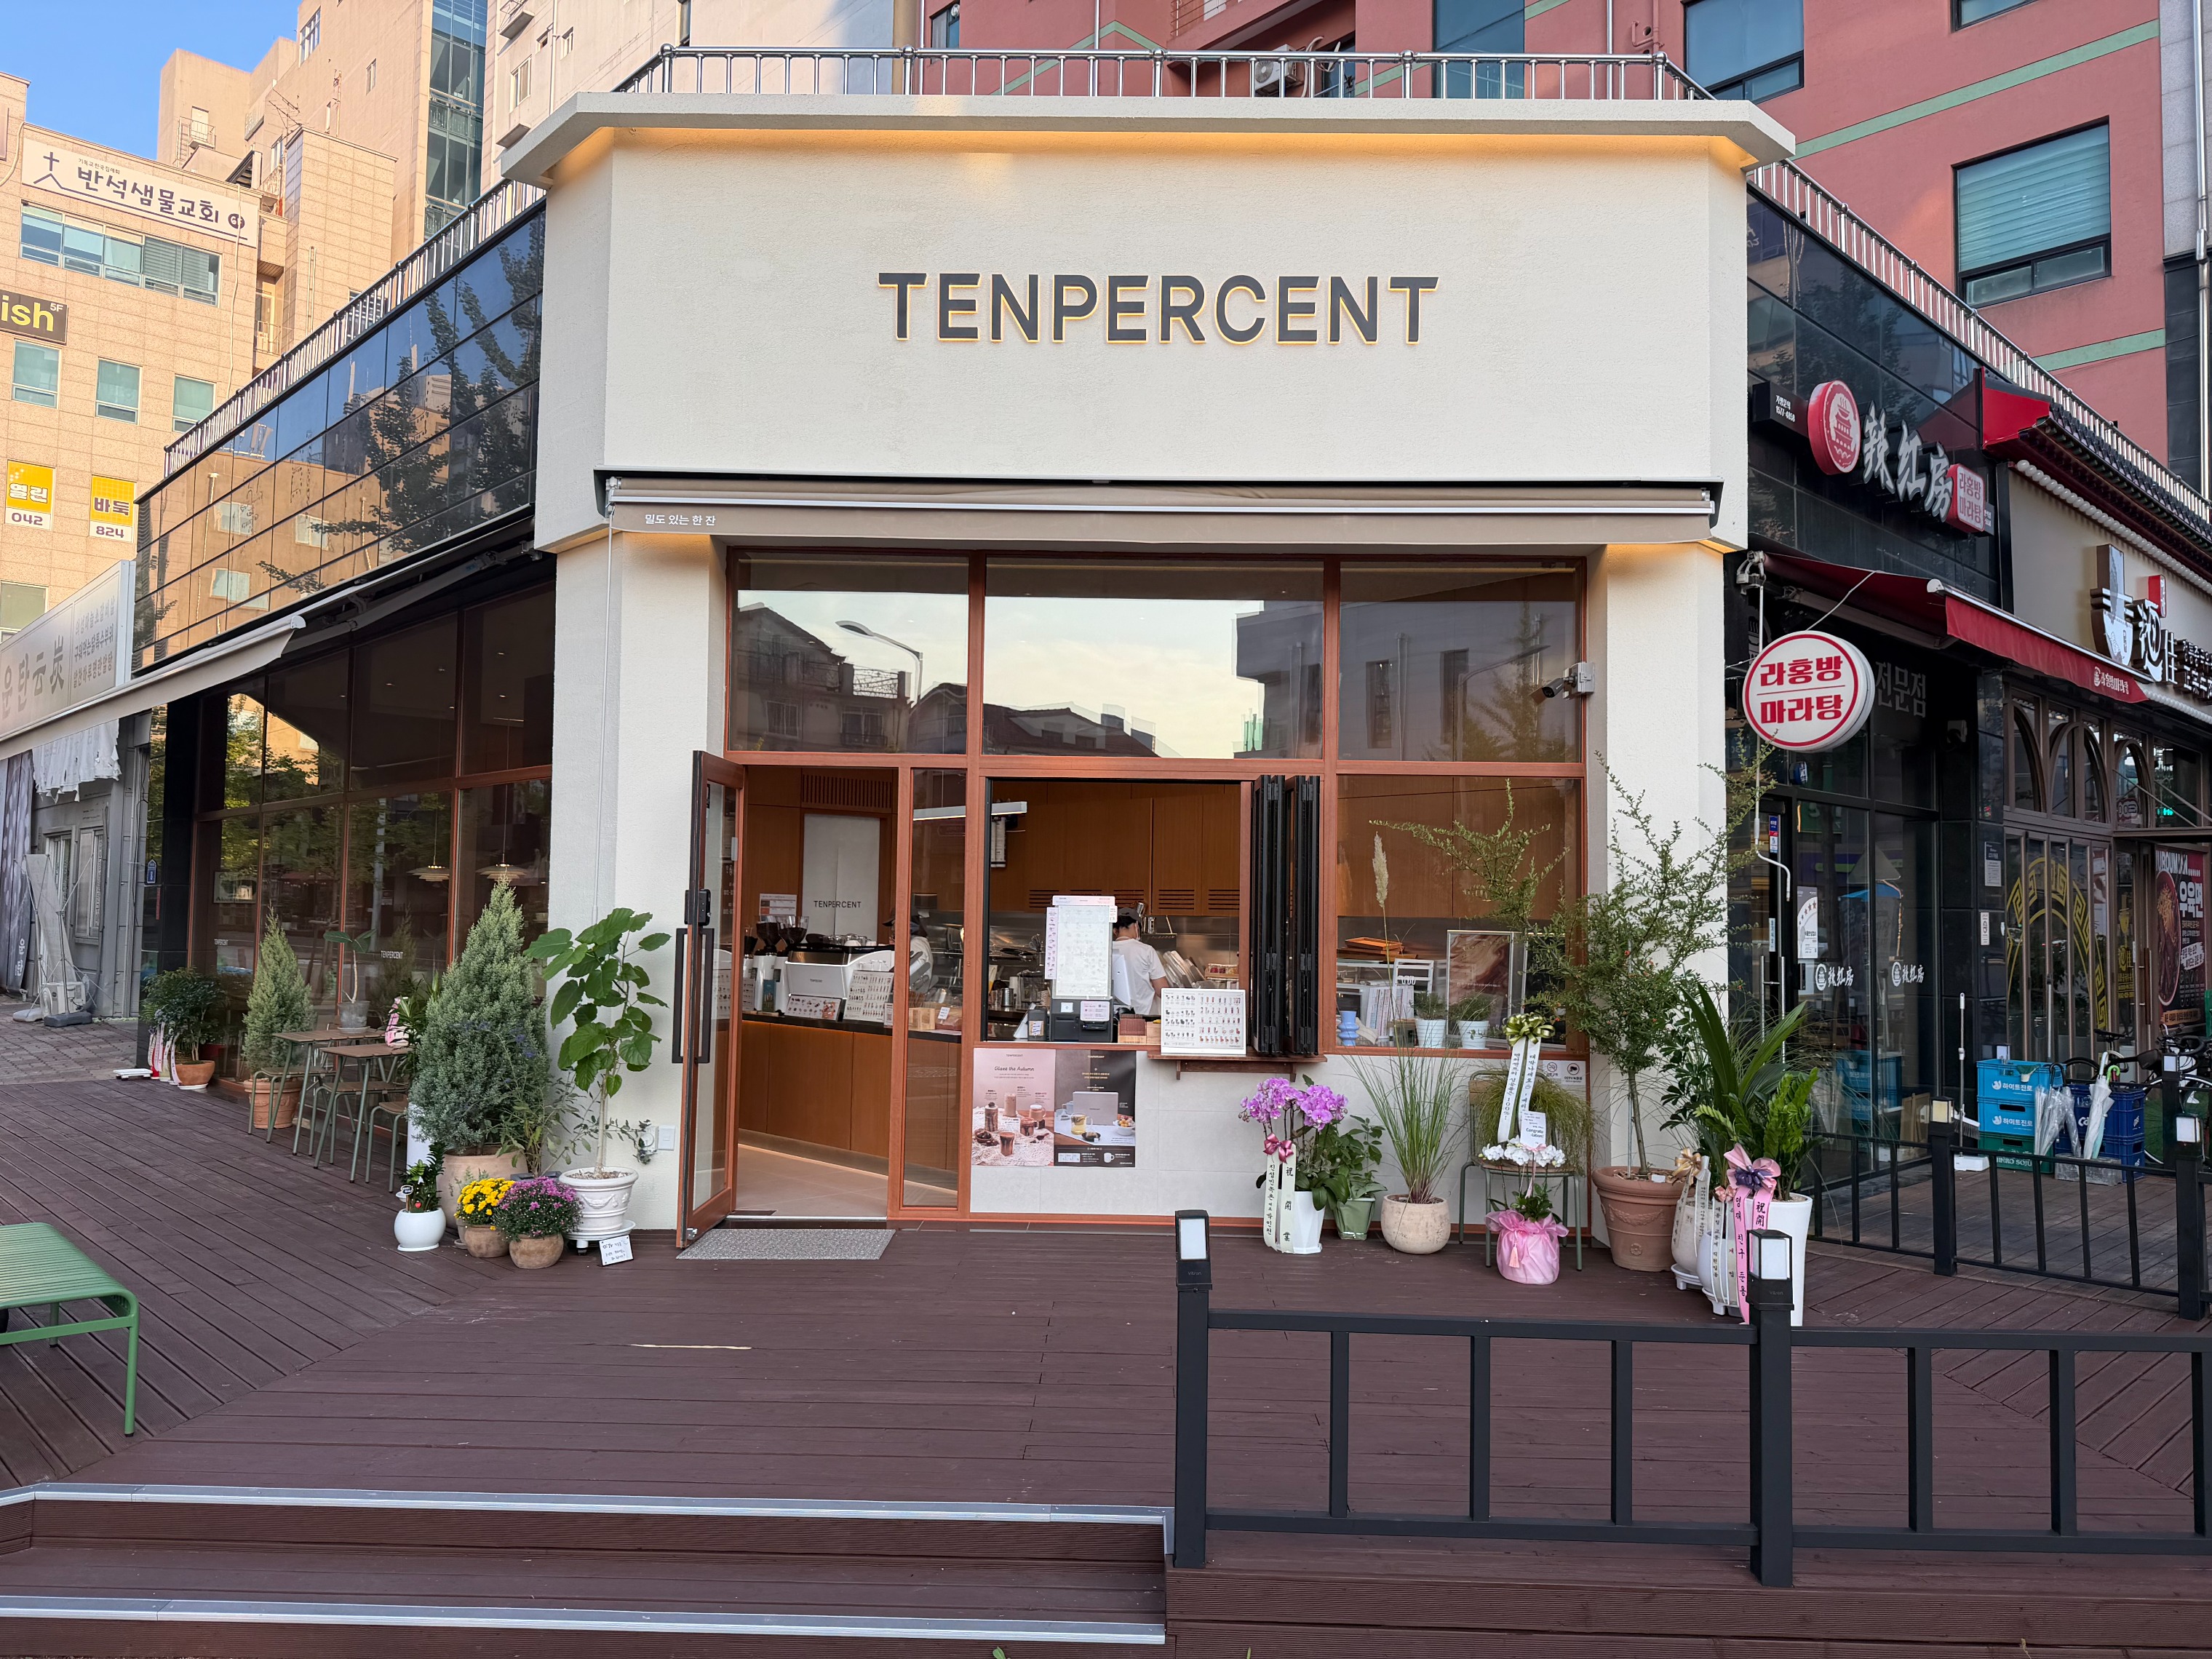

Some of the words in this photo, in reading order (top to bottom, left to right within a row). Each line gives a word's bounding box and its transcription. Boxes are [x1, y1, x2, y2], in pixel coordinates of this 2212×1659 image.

[77, 167, 219, 224] 반석샘물교회
[49, 302, 64, 313] 5F
[878, 272, 1439, 345] TENPERCENT
[1959, 472, 1981, 501] 라홍방
[94, 497, 130, 516] 바둑
[1959, 496, 1982, 524] 마라탕
[12, 512, 43, 526] 042
[645, 514, 666, 525] 밀도
[668, 514, 690, 525] 있는
[692, 515, 703, 526] 한
[705, 515, 716, 526] 잔
[95, 526, 124, 538] 824
[1759, 656, 1844, 687] 라홍방
[1875, 661, 1927, 718] 전문점
[1760, 694, 1844, 724] 마라탕
[813, 900, 862, 909] TENPERCENT
[381, 950, 404, 960] TENPERCENT
[2002, 1083, 2034, 1091] 하이트진로
[2002, 1118, 2034, 1127] 하이트진로
[1738, 1233, 1746, 1259] 친구
